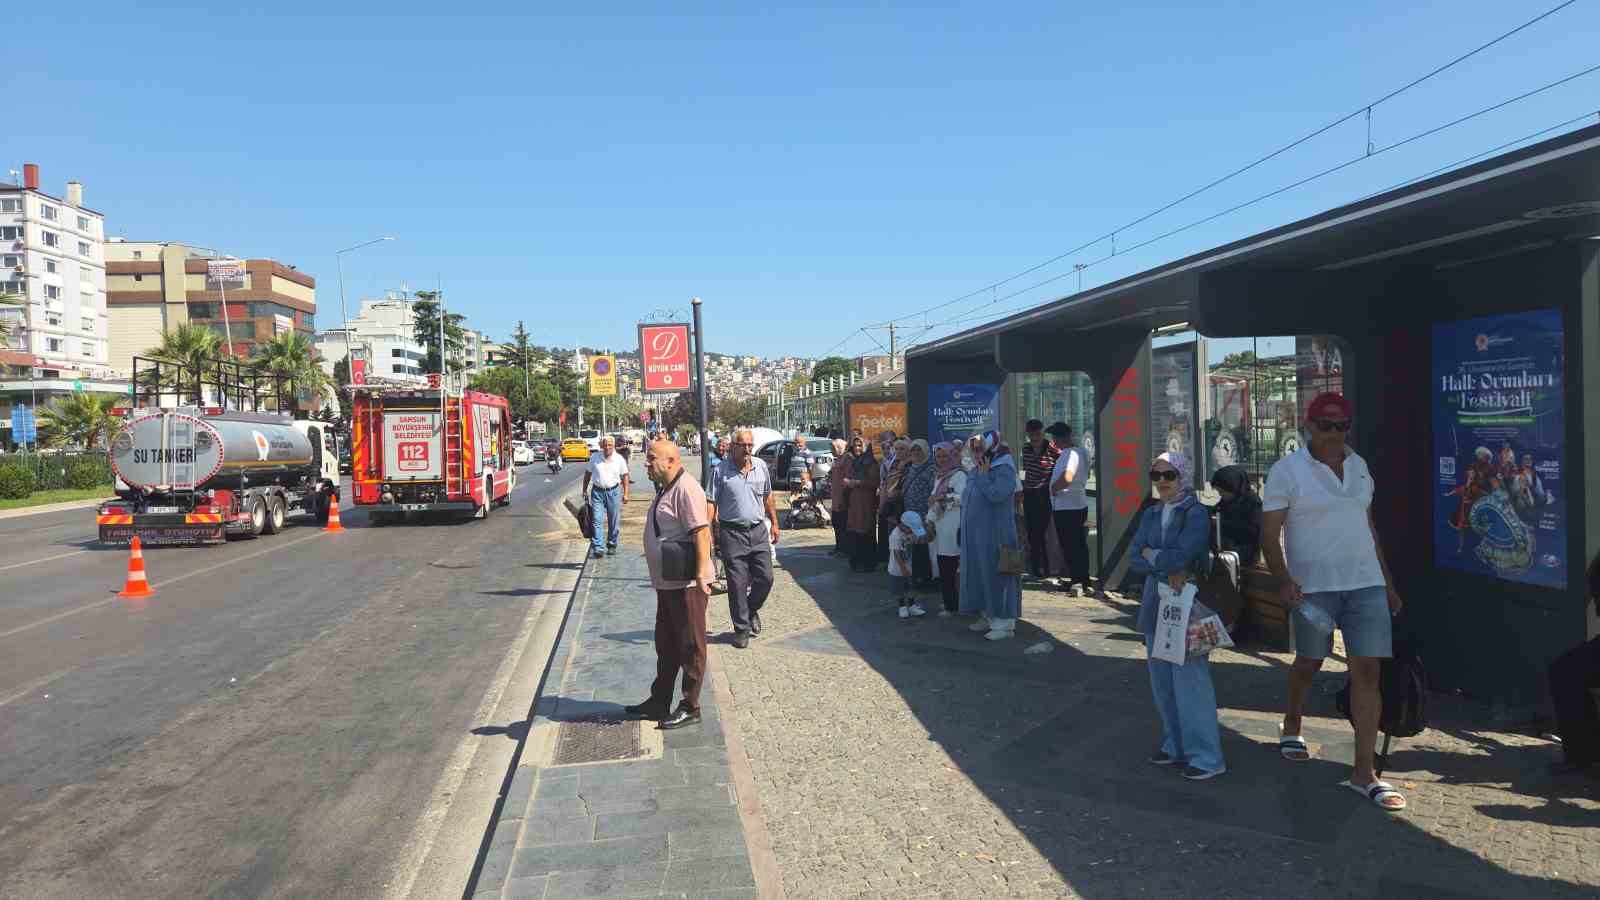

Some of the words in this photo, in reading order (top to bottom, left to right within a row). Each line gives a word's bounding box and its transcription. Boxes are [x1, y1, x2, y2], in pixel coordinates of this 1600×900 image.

[652, 331, 680, 360] D
[1442, 374, 1477, 392] Halk
[1460, 390, 1532, 409] Festivali
[134, 448, 148, 464] SU
[401, 445, 425, 460] 112
